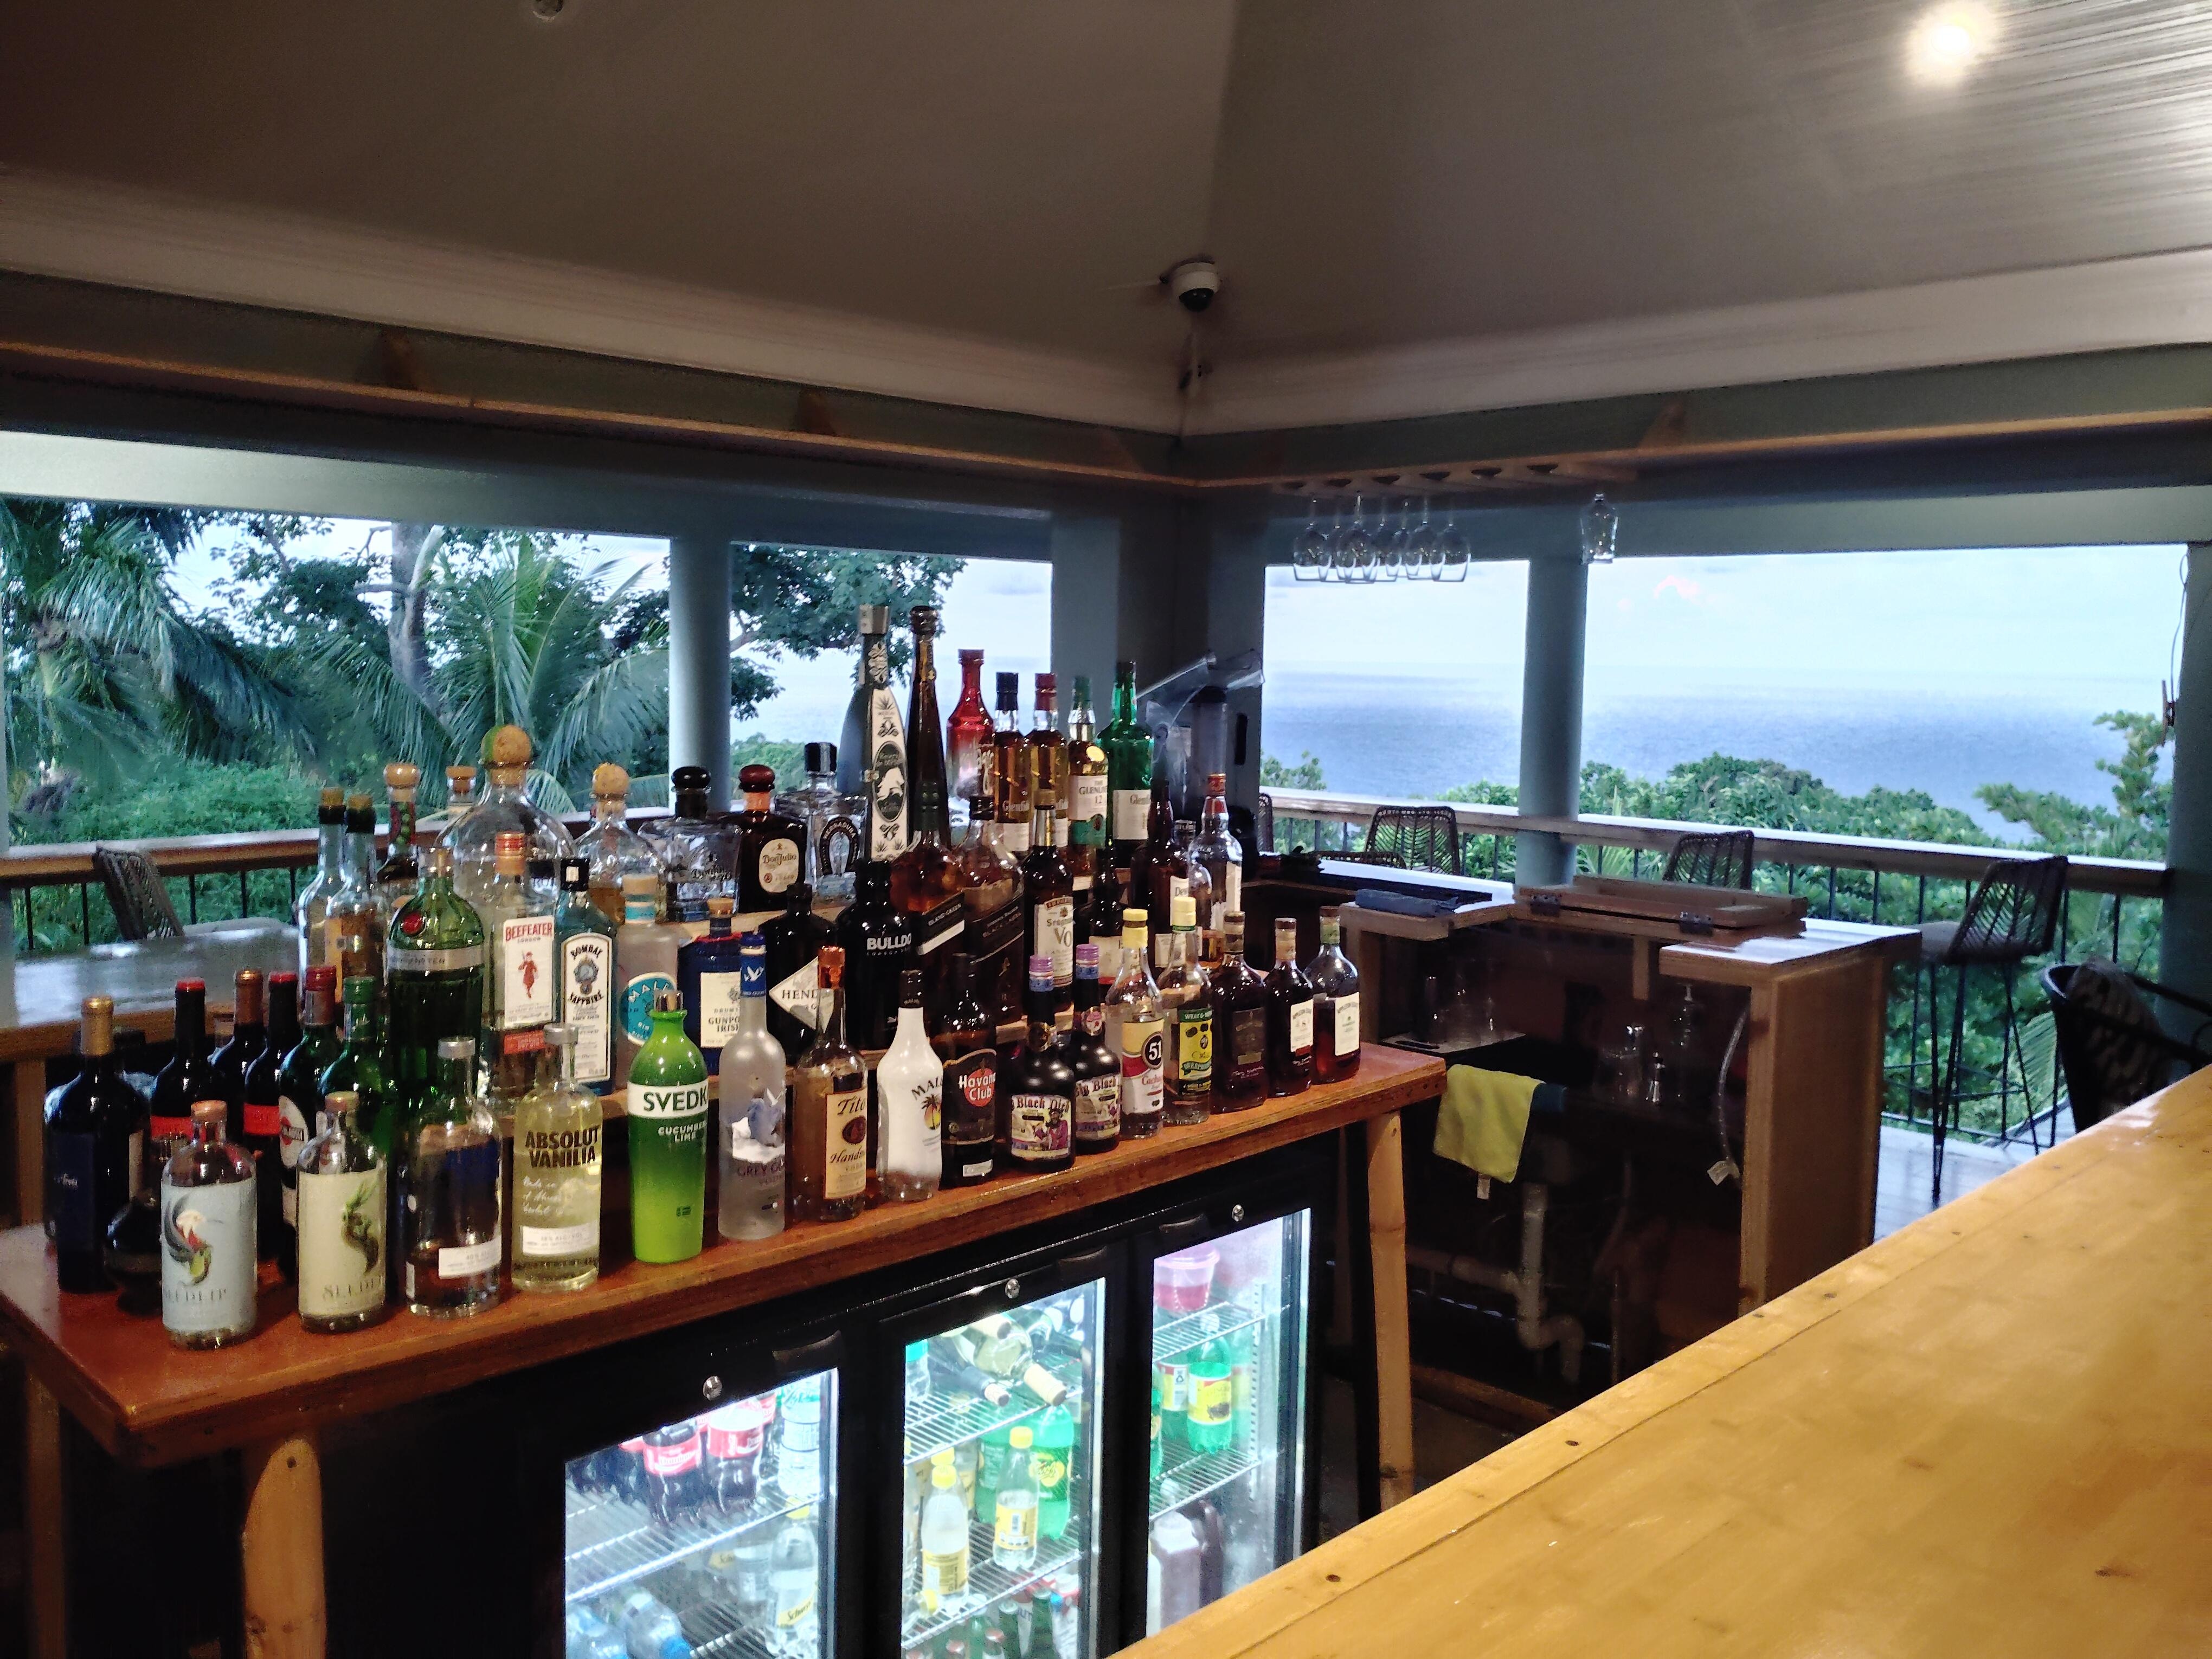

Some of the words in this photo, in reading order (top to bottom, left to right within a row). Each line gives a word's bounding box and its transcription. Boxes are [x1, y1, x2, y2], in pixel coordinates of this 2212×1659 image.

[505, 922, 552, 942] BEEFEATER
[570, 944, 603, 959] BOMBAY
[568, 990, 604, 1005] SAPPHIRE
[1148, 1039, 1162, 1061] 51
[969, 1086, 992, 1101] Club
[525, 1125, 600, 1149] ABSOLUT
[529, 1146, 596, 1168] VANILIA
